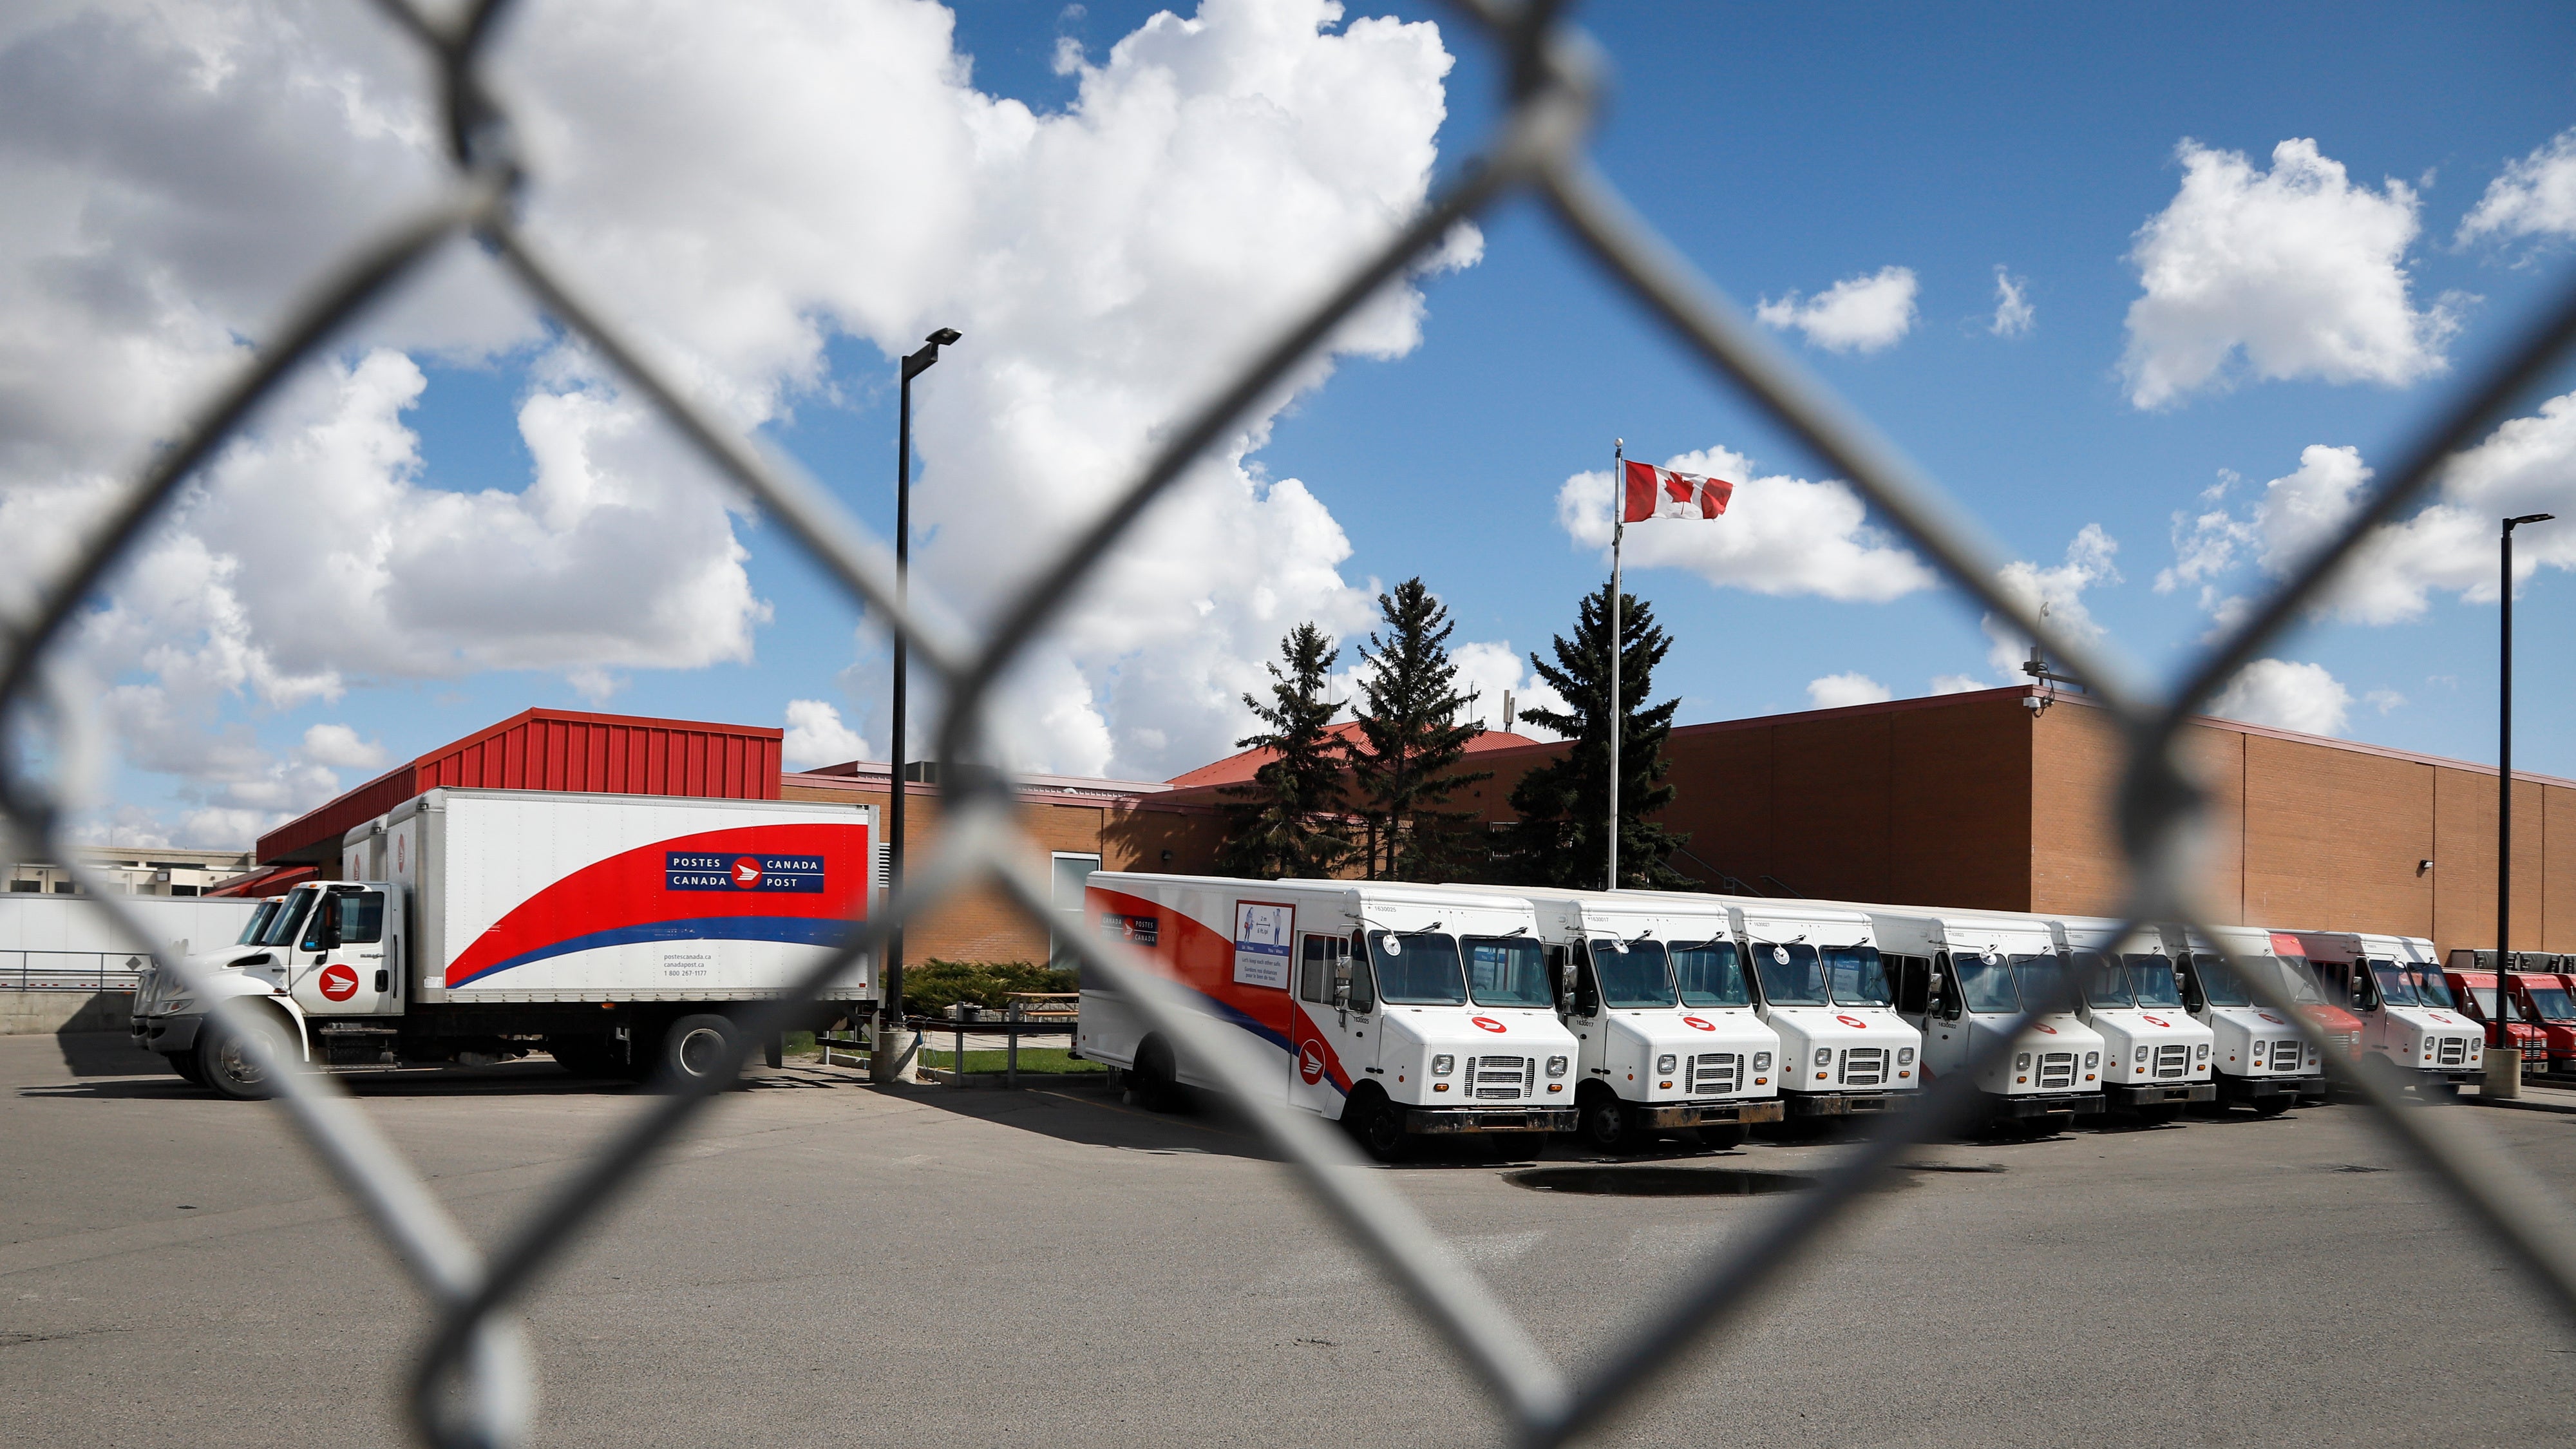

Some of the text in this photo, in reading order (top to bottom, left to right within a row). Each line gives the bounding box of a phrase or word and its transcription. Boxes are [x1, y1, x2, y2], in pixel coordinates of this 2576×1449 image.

[673, 858, 818, 870] POSTES CANADA
[673, 876, 797, 887] CANADA POST
[1103, 917, 1122, 925] CANADA
[1135, 934, 1155, 942] CANADA
